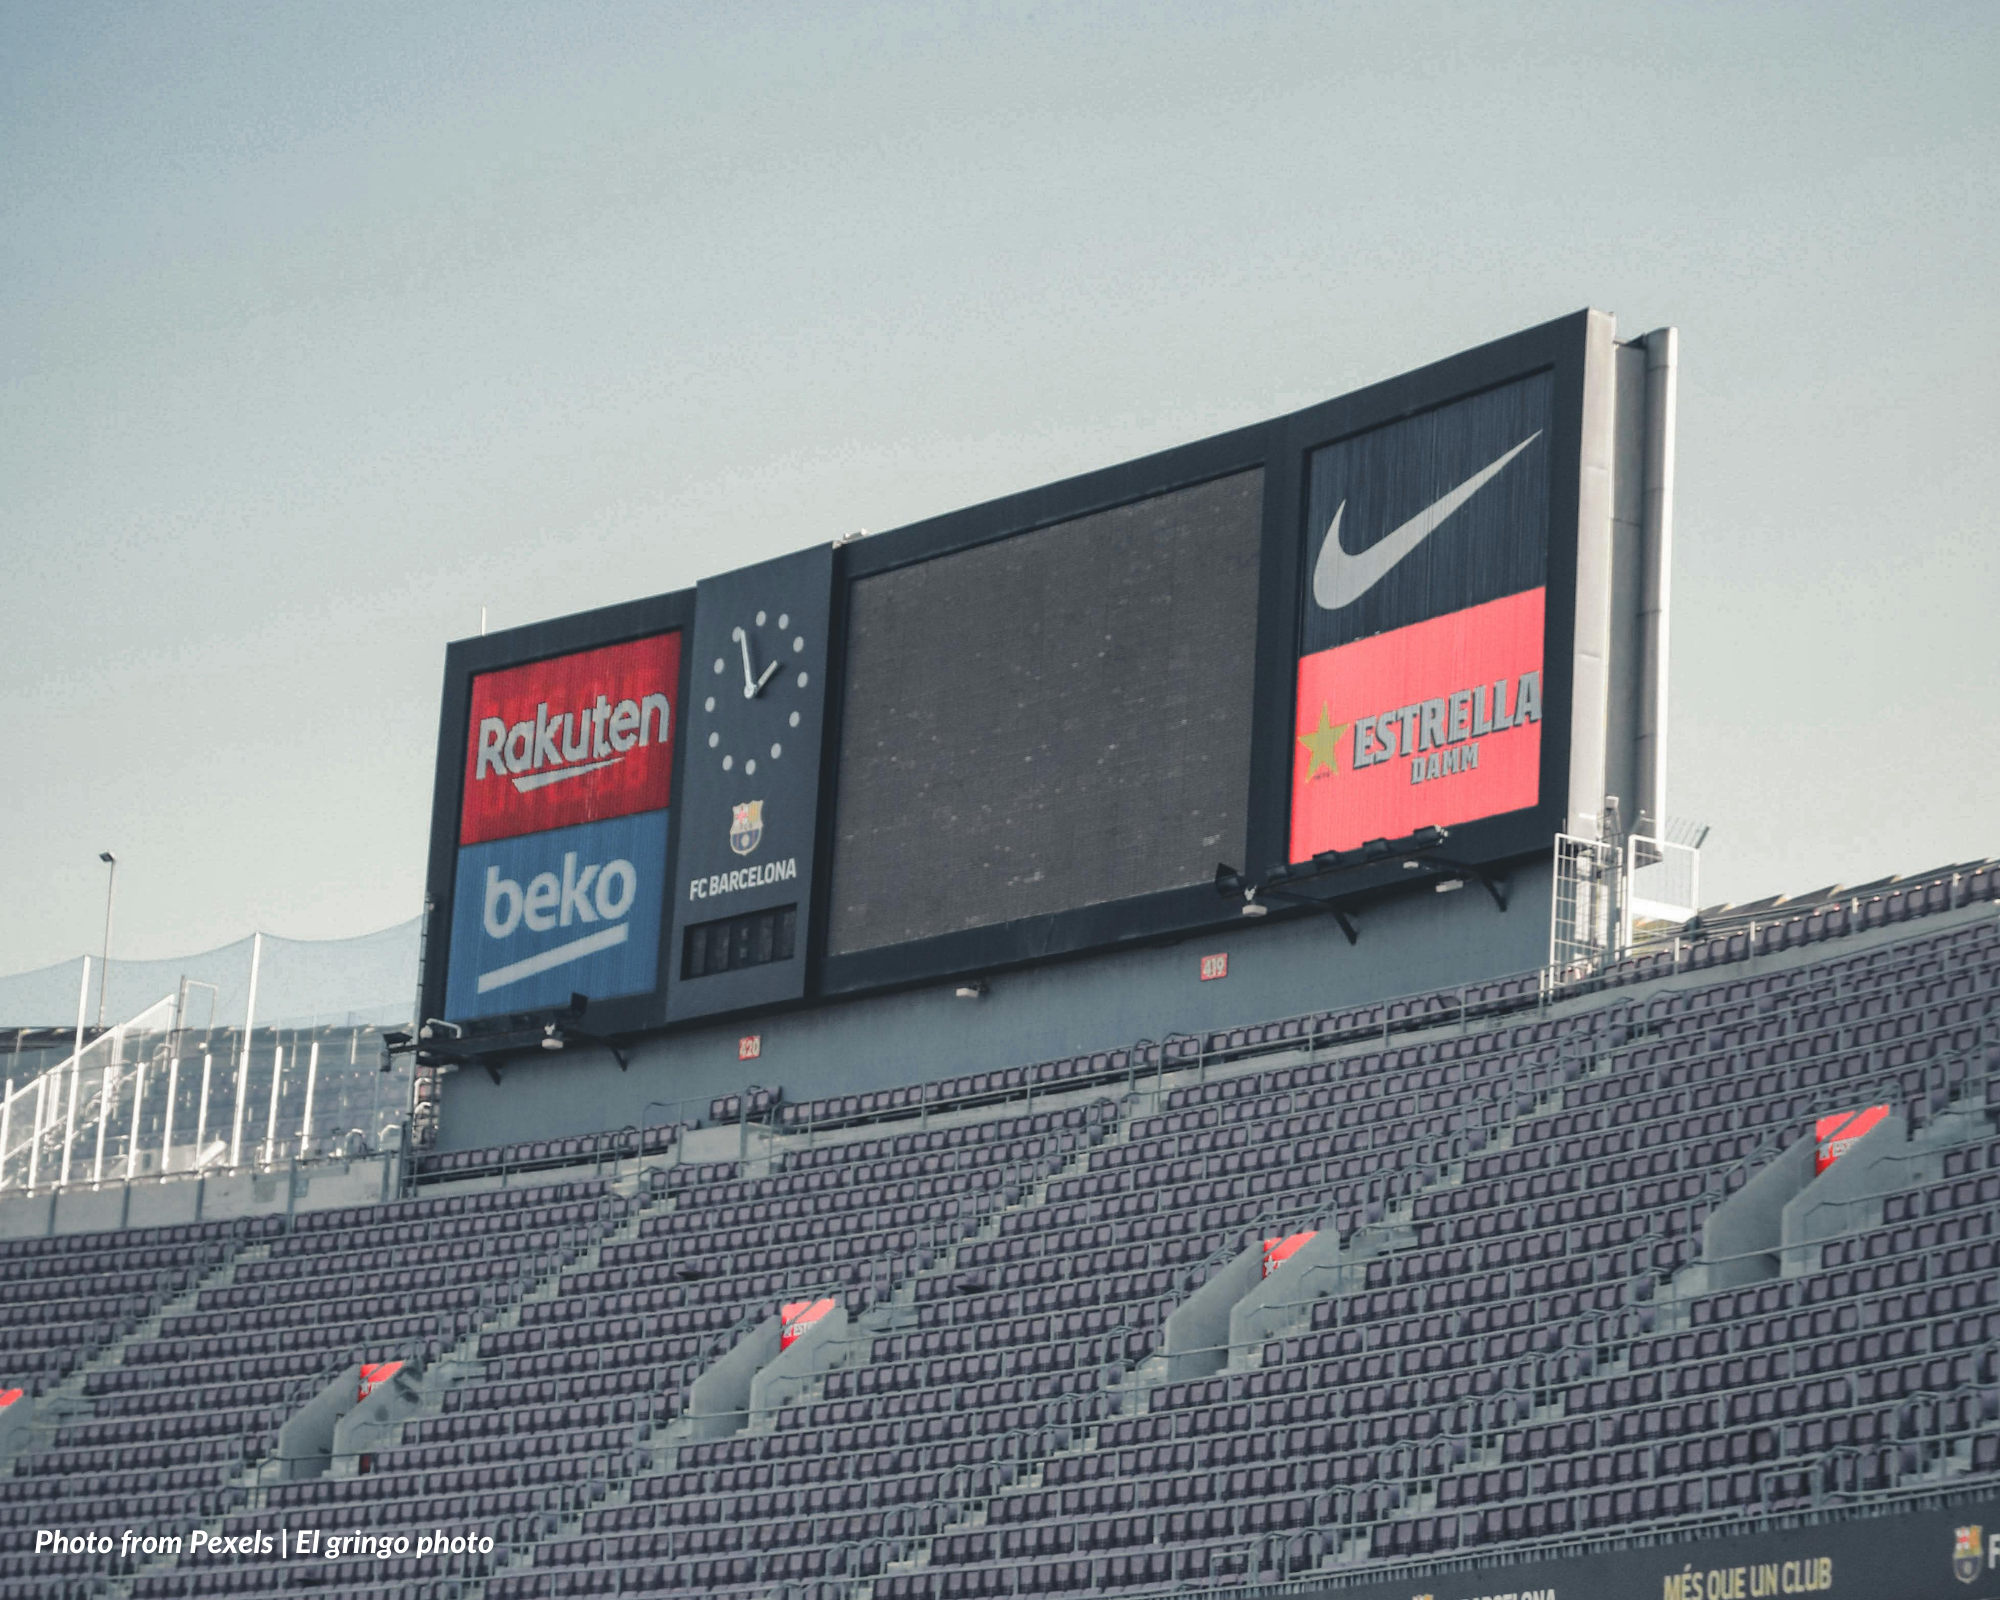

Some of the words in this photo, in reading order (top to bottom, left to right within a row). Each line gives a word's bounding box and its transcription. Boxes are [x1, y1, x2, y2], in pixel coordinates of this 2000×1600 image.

[476, 692, 670, 780] Rakuten
[1353, 671, 1542, 769] ESTRELLA
[1411, 743, 1479, 785] DAMM
[483, 851, 637, 939] beko
[690, 878, 707, 901] FC
[709, 858, 797, 896] BARCELONA
[1203, 956, 1225, 978] 419
[1663, 1563, 1704, 1600] MÉS
[1707, 1566, 1746, 1600] QUE
[1750, 1563, 1779, 1598] UN
[1782, 1556, 1832, 1594] CLUB
